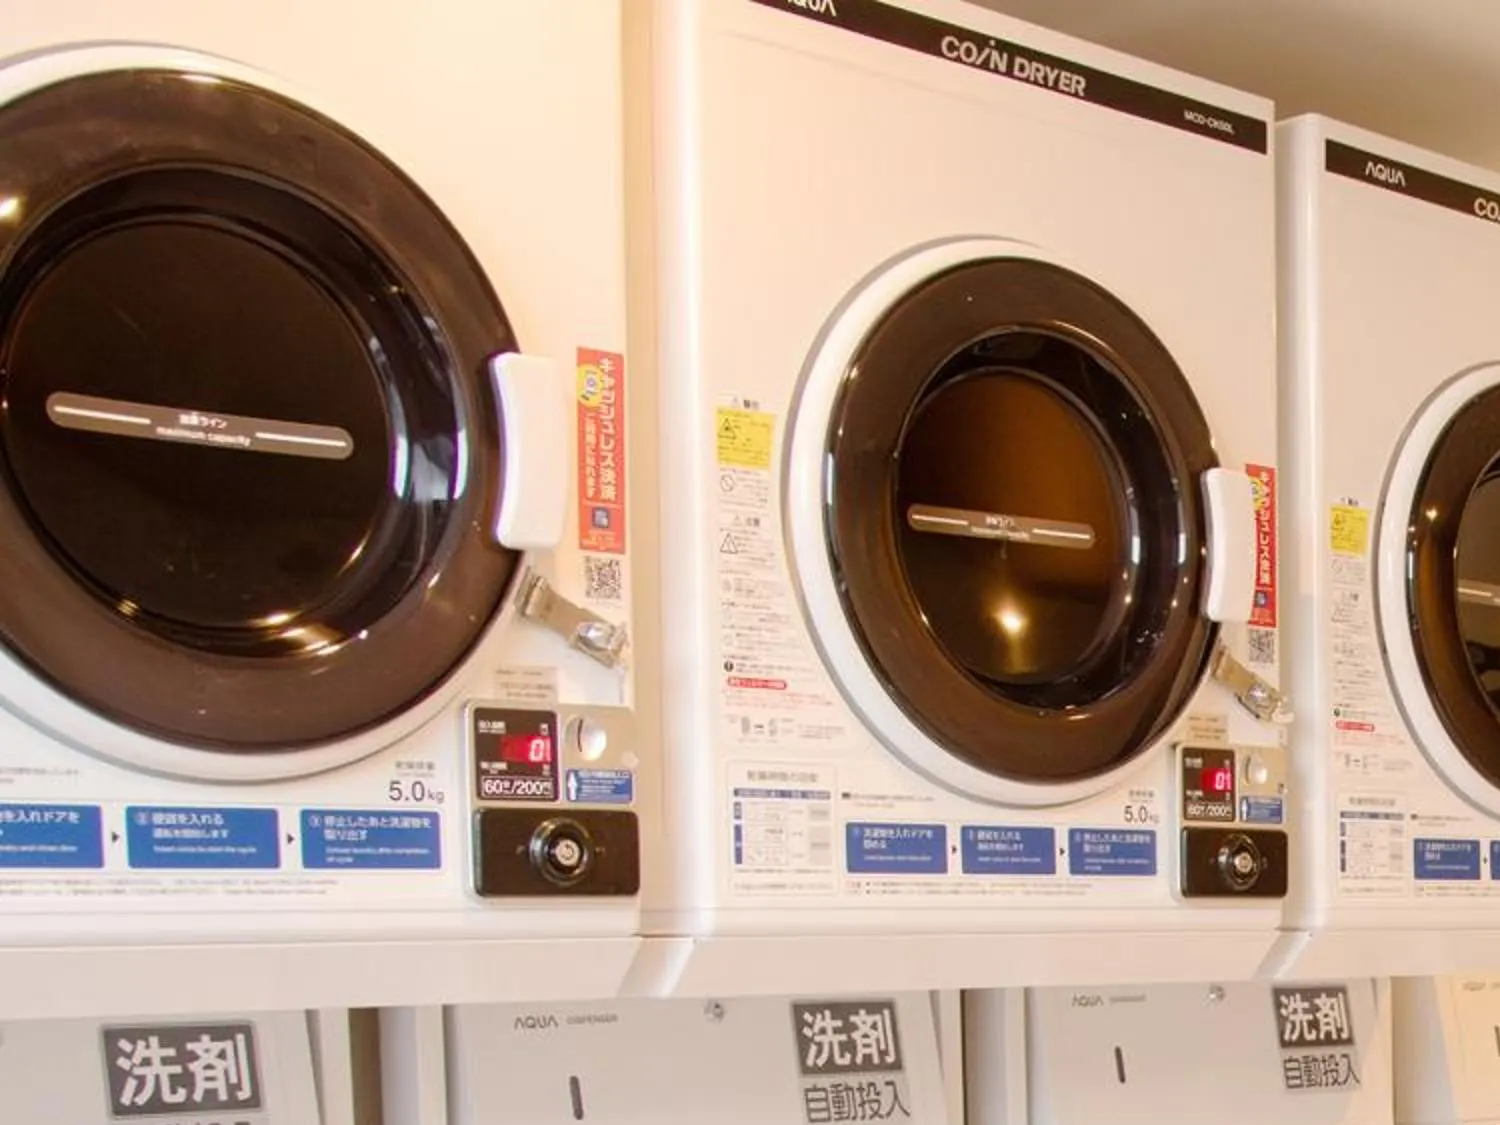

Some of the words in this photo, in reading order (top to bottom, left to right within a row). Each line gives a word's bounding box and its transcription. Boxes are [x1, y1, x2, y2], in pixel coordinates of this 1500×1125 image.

[1014, 56, 1086, 96] DRYER
[1365, 161, 1406, 187] AQUA
[514, 1014, 559, 1030] AQUA
[1280, 991, 1350, 1042] 洗剤
[802, 1008, 896, 1067] 洗剤
[115, 1033, 252, 1107] 洗剤
[1283, 1053, 1360, 1089] 自動投入
[804, 1080, 910, 1123] 自動投入
